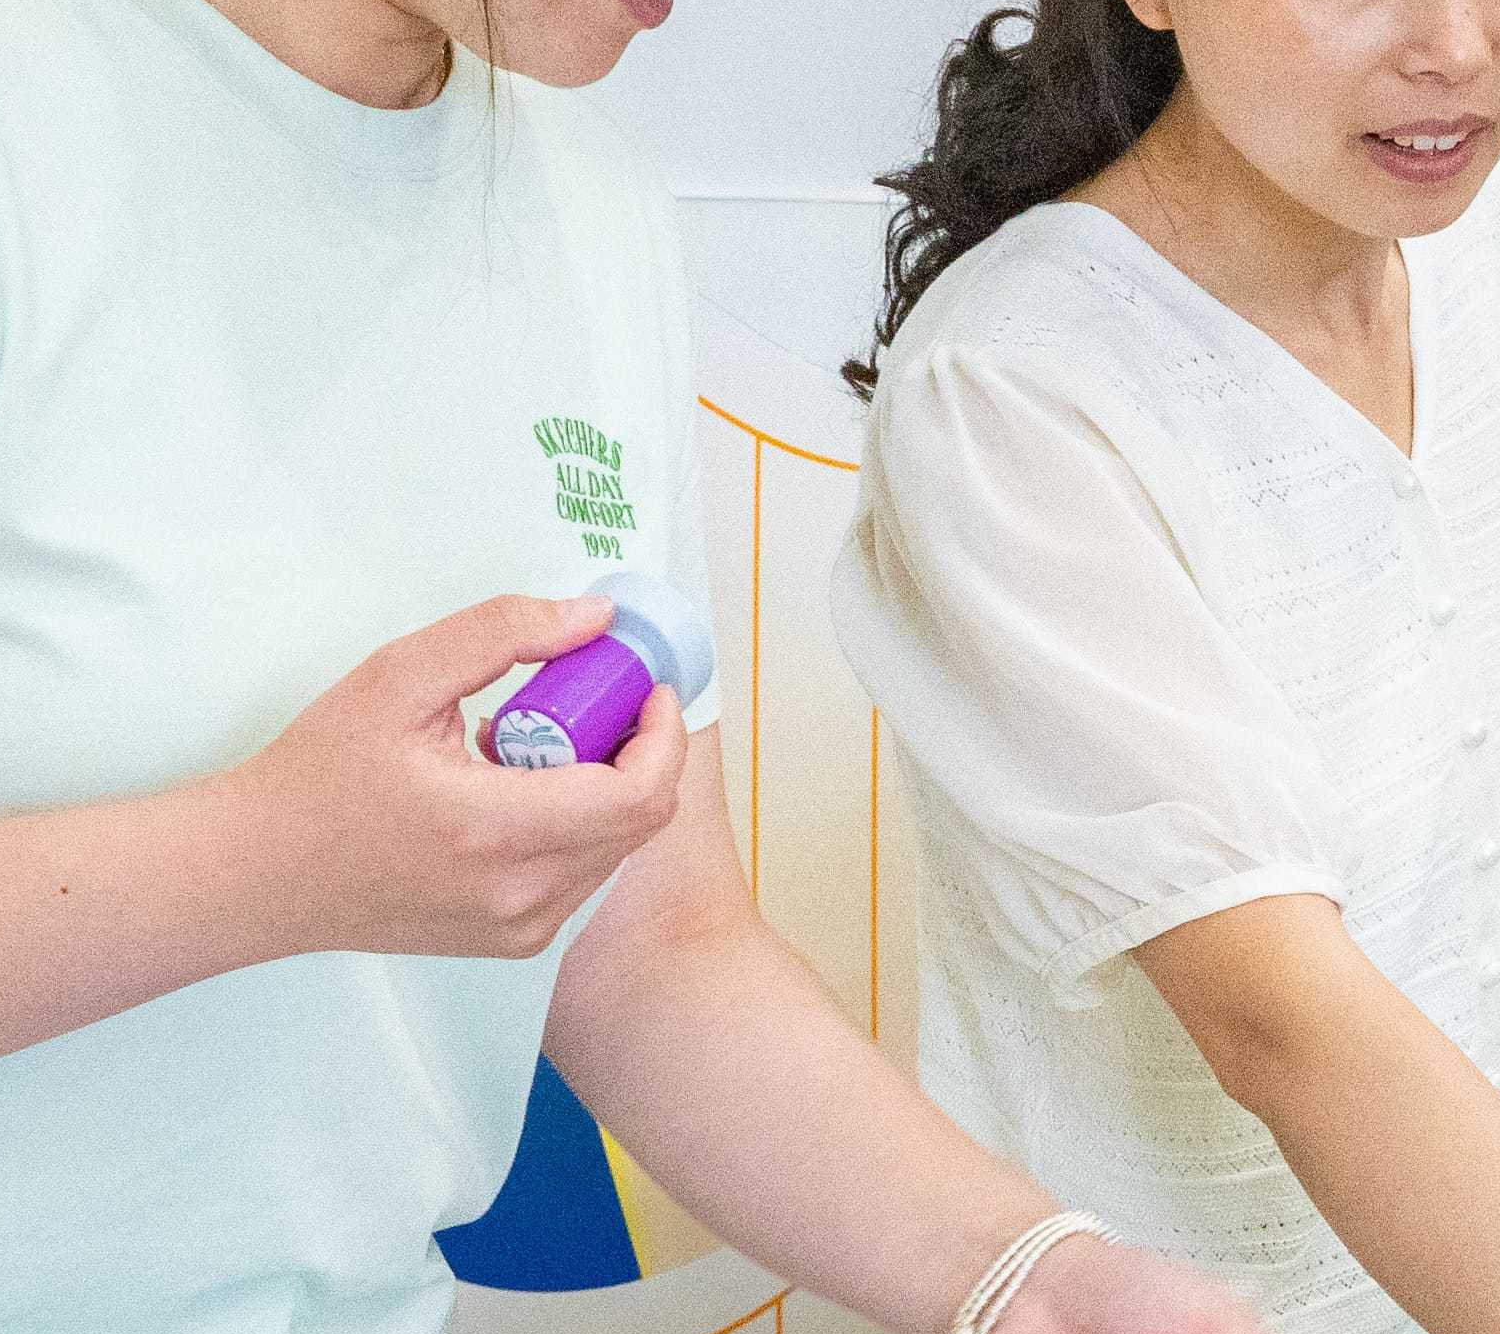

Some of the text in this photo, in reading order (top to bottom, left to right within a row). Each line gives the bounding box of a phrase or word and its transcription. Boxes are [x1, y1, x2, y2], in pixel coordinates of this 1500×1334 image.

[533, 417, 623, 471] SKECHERS
[556, 462, 624, 500] ALL DAY
[556, 492, 637, 531] COMFORT
[581, 532, 623, 561] 1992
